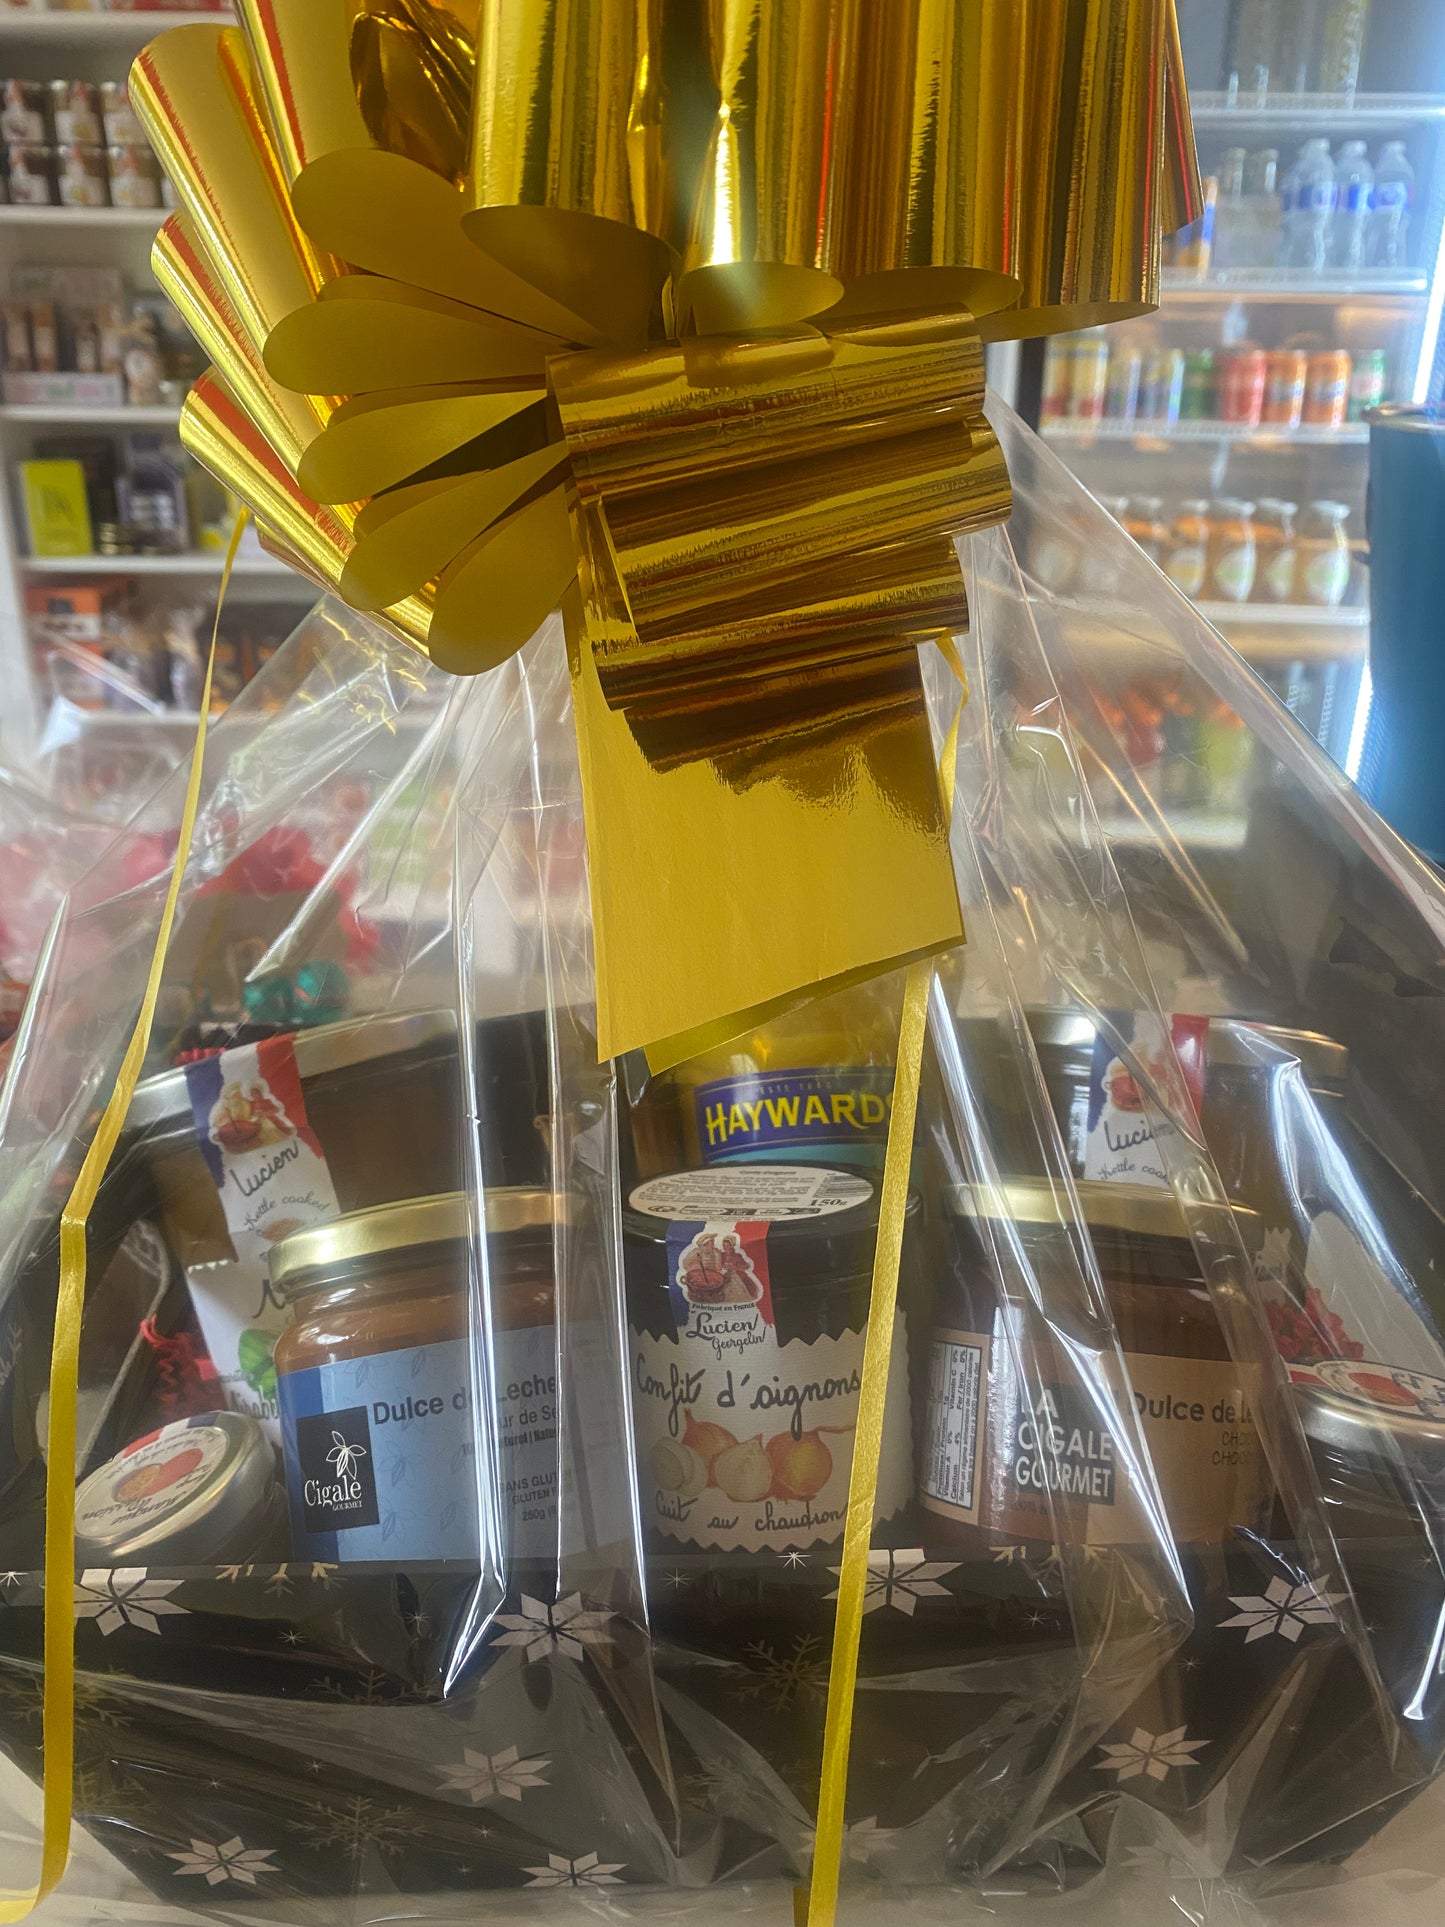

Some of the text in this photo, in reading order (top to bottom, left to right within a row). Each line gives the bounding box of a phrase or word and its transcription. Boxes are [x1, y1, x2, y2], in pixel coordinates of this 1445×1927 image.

[1104, 1120, 1175, 1152] Luci
[229, 1139, 299, 1197] Lucien
[733, 1301, 756, 1311] France
[686, 1311, 759, 1342] Lucien
[711, 1325, 767, 1361] Georgelin
[949, 1377, 957, 1410] Vitamin
[957, 1371, 965, 1389] Iron
[372, 1395, 444, 1426] Dulce
[452, 1386, 473, 1411] d
[636, 1352, 706, 1437] Confit
[716, 1369, 862, 1442] d'oignons
[956, 1395, 964, 1410] Fer
[1128, 1392, 1205, 1422] Dulce
[1211, 1398, 1236, 1423] de
[519, 1408, 538, 1426] de
[1017, 1420, 1114, 1462] CIGALE
[304, 1474, 362, 1508] Cigale
[943, 1464, 951, 1497] Vitamin
[950, 1463, 959, 1500] Calcium
[1015, 1455, 1112, 1498] GOURMET
[332, 1500, 363, 1512] GOURMET
[655, 1489, 849, 1532] Cuit au chaudron
